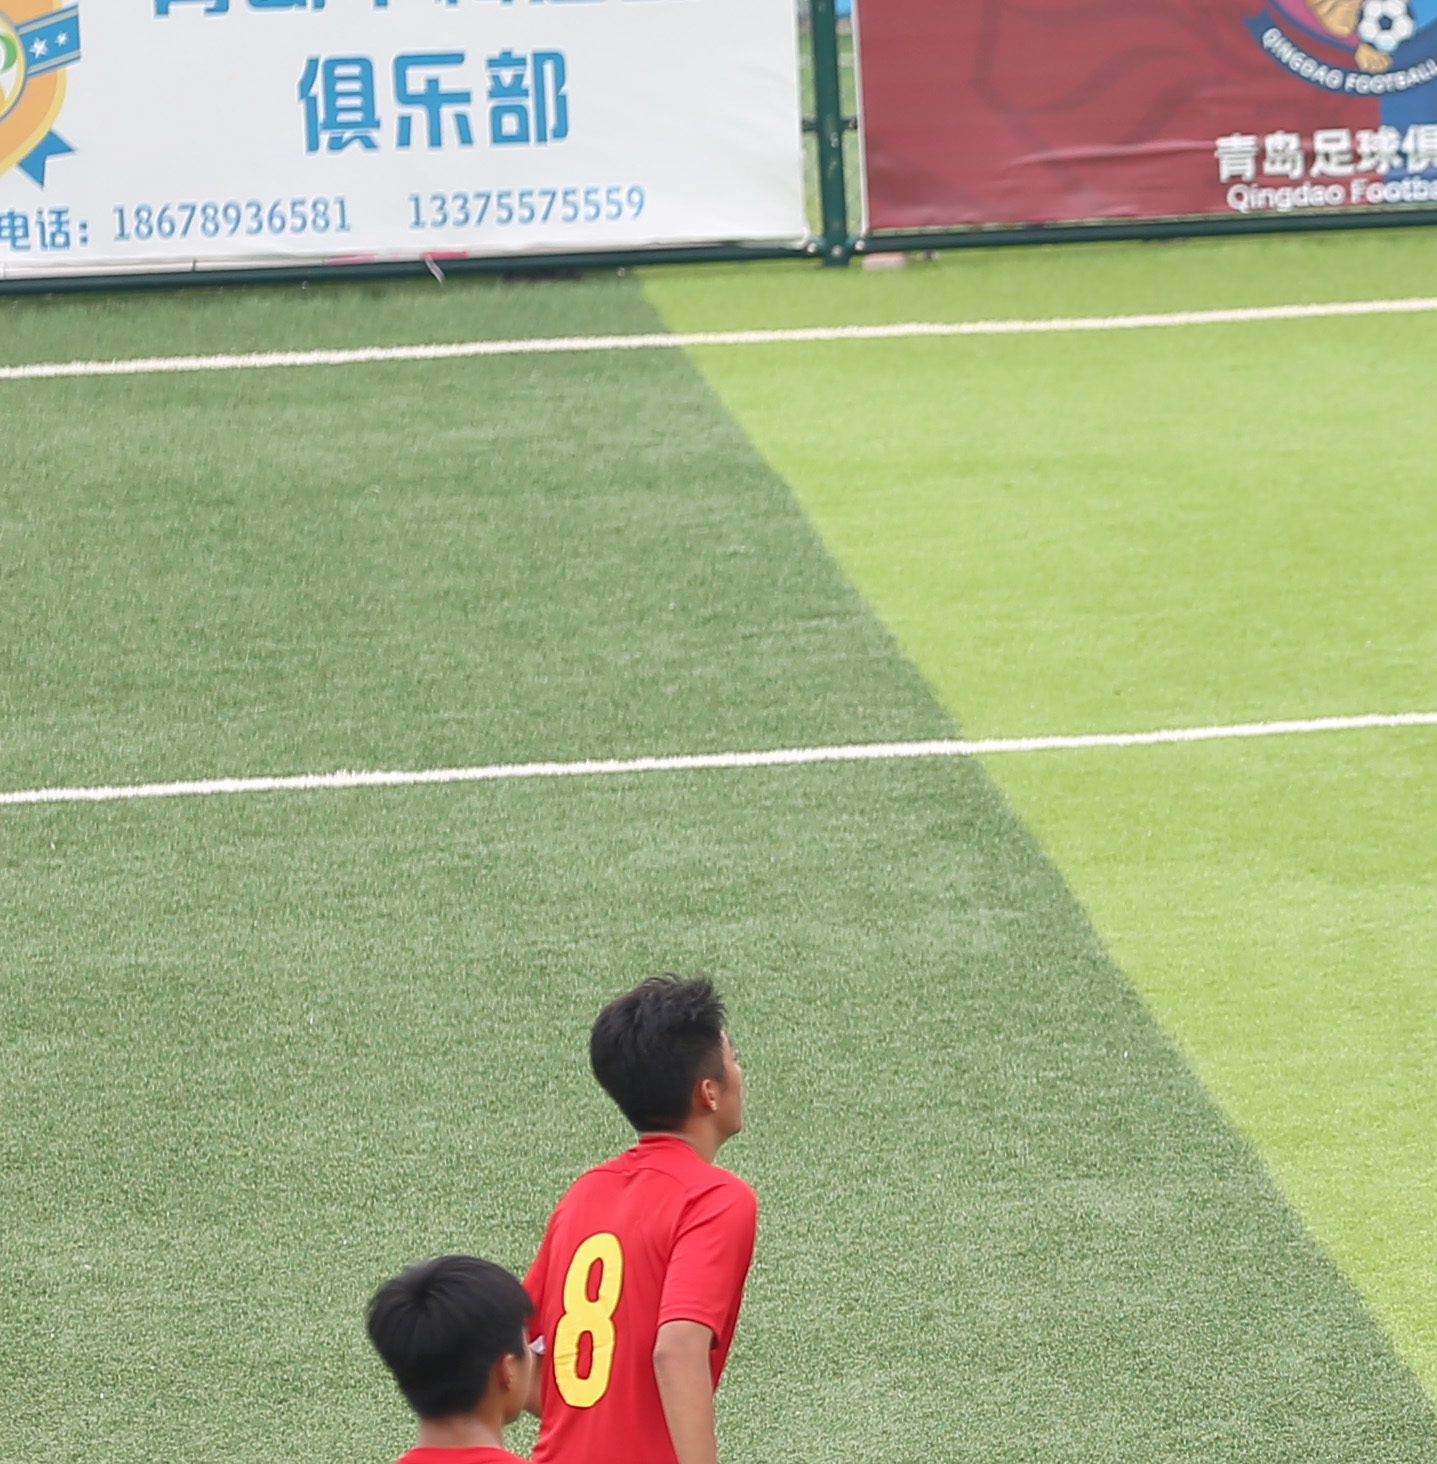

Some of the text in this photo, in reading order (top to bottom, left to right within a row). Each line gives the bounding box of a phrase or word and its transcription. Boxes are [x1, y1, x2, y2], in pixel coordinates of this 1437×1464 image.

[1262, 27, 1343, 89] QINGDAO
[298, 49, 569, 152] 俱乐部
[113, 197, 351, 241] 18678936581
[408, 184, 646, 230] 13375575559
[1227, 182, 1346, 213] Qingdao
[553, 1232, 624, 1408] 8
